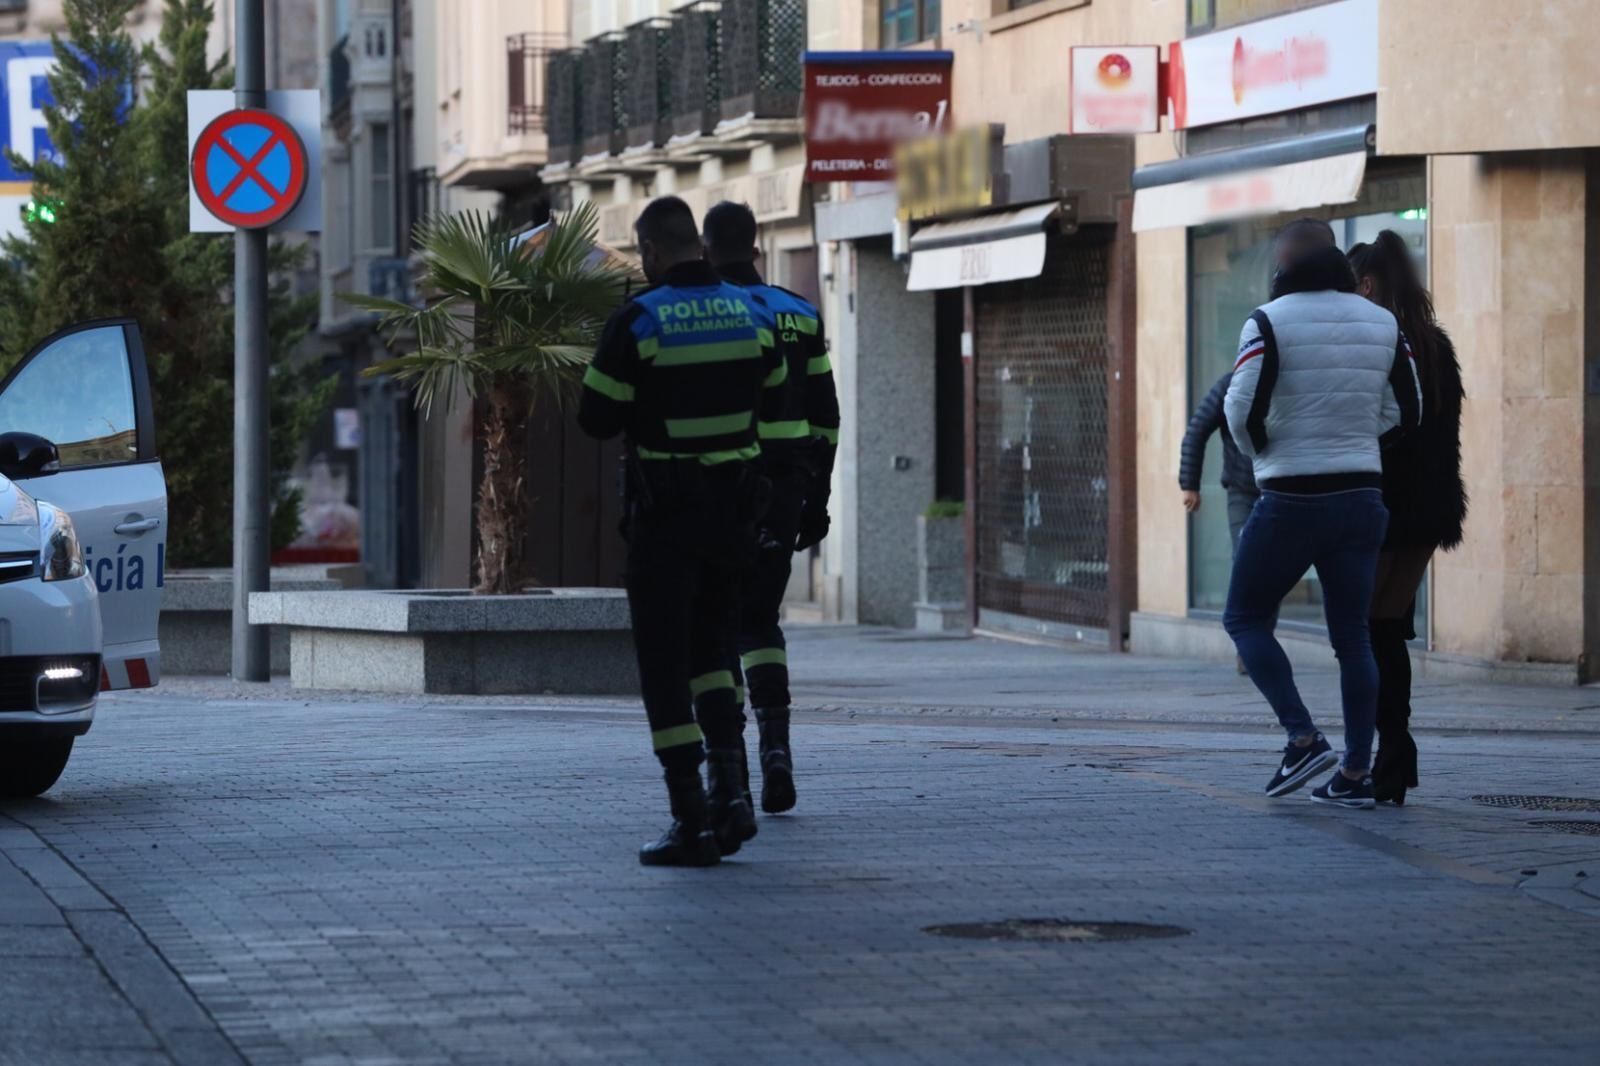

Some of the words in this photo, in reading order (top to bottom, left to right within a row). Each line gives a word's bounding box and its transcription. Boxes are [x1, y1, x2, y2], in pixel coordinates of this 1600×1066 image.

[816, 74, 860, 87] TEJIDOS
[867, 73, 942, 86] CONFECCION
[811, 159, 866, 171] PELETERIA
[874, 159, 890, 170] DE
[657, 298, 749, 321] POLICIA
[662, 316, 753, 335] SALAMANCA
[782, 331, 798, 342] CA
[85, 543, 144, 592] icía
